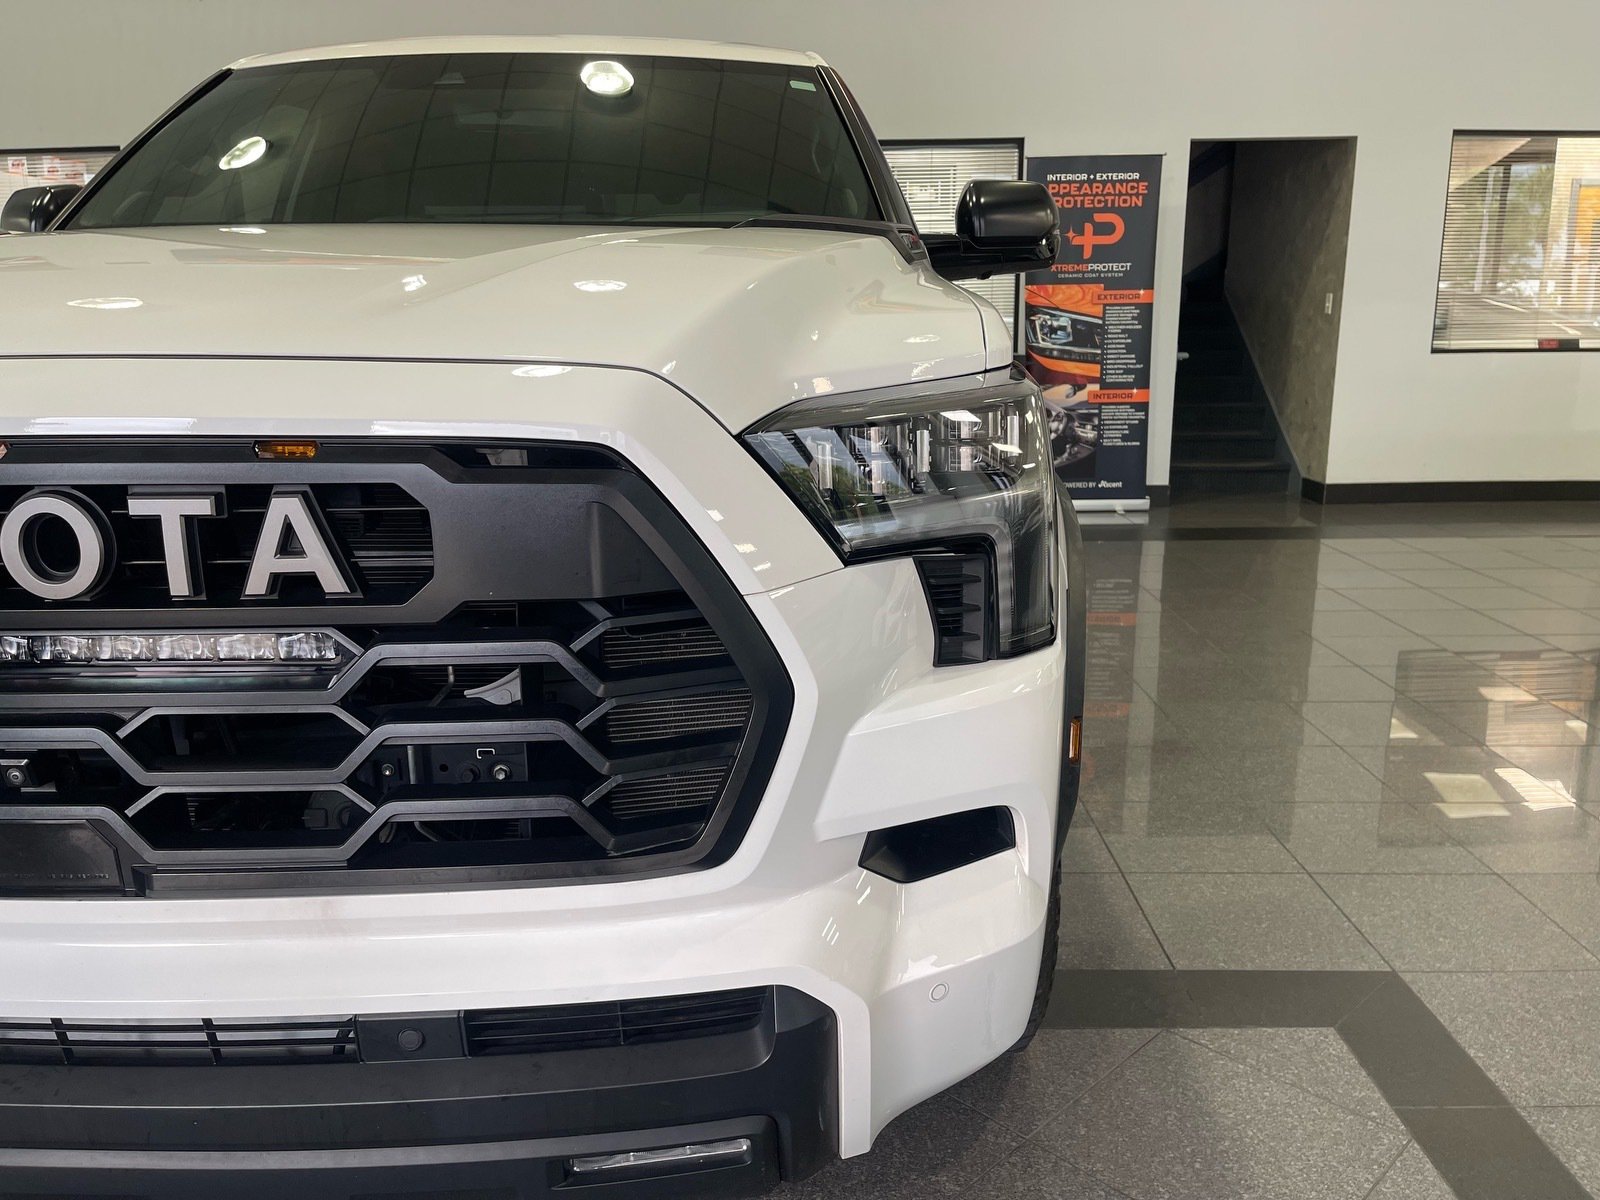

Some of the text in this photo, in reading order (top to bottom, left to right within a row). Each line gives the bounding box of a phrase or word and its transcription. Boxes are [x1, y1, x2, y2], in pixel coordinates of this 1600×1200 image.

[1047, 173, 1088, 181] INTERIOR
[1096, 172, 1140, 180] EXTERIOR
[1048, 182, 1148, 195] PPEARANCE
[1055, 195, 1143, 208] ROTECTION
[1097, 293, 1141, 301] EXTERIOR
[1092, 392, 1133, 400] INTERIOR
[1063, 481, 1087, 489] OWERED
[1088, 481, 1096, 489] BY
